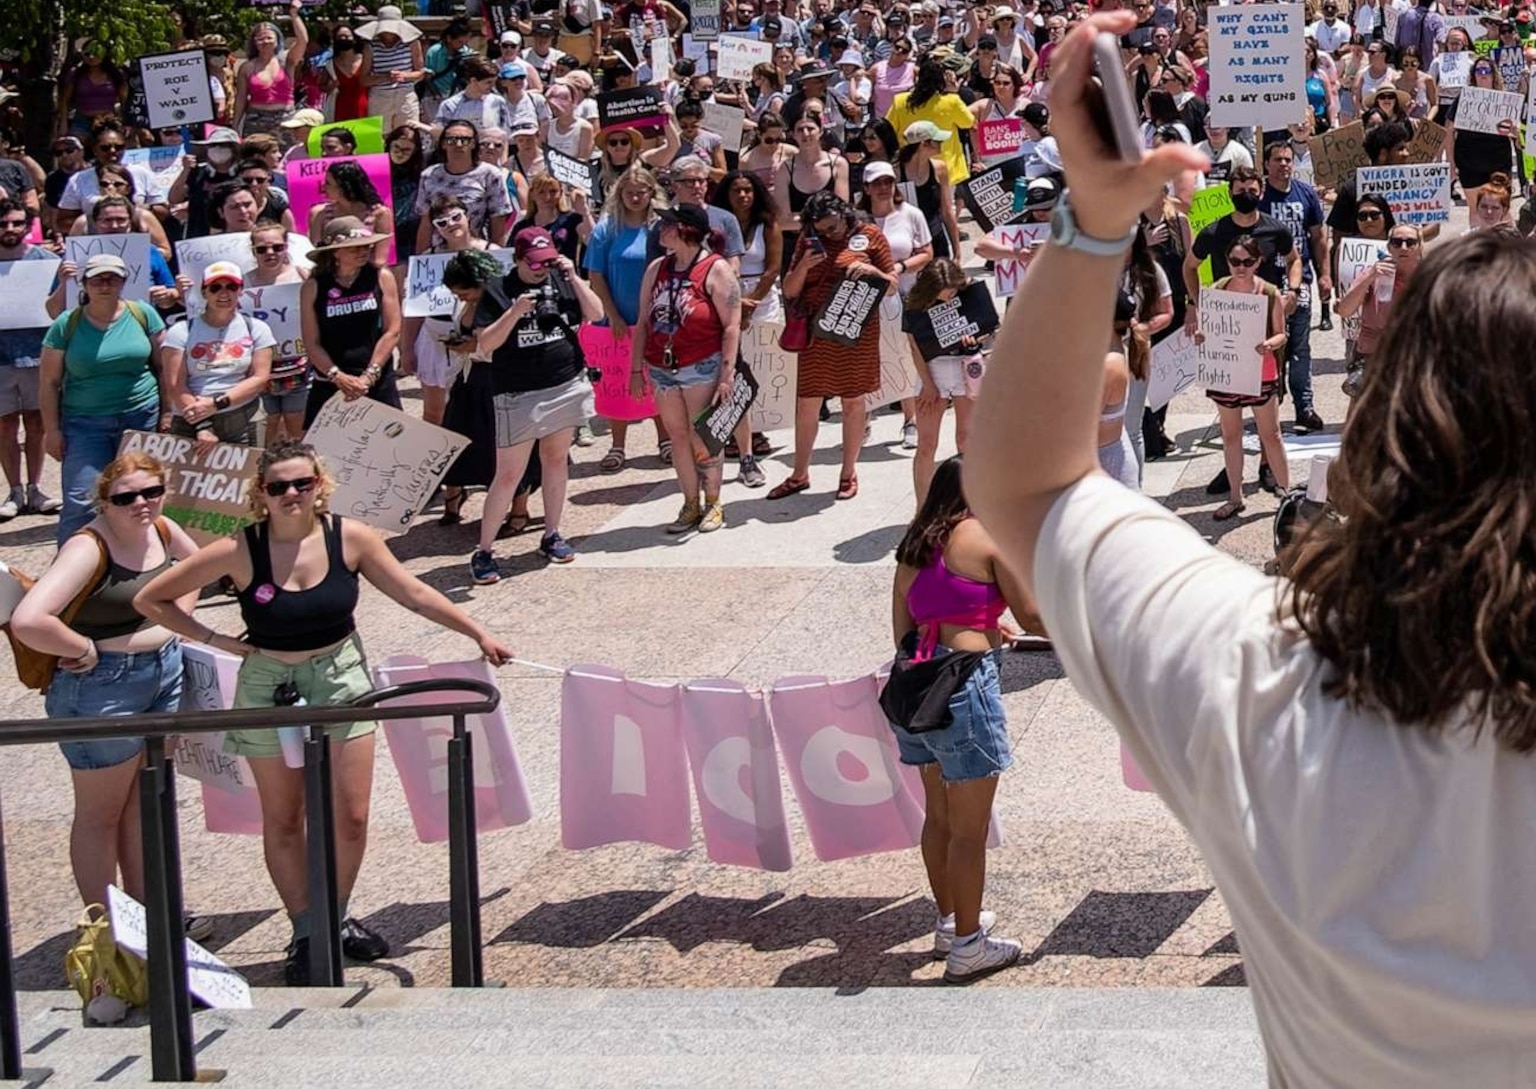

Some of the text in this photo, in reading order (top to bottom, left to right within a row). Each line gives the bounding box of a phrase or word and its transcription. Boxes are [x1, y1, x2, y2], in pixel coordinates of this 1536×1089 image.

[1216, 14, 1242, 23] WHY
[1221, 24, 1289, 34] MY GIRLS
[1233, 41, 1269, 49] HAVE
[144, 57, 202, 71] PROTECT
[1228, 55, 1290, 66] AS MANY
[163, 75, 190, 86] ROE
[1234, 74, 1285, 84] RIGHTS
[171, 87, 180, 95] V
[1218, 92, 1296, 104] AS MY GUNS
[158, 96, 198, 109] WADE
[606, 96, 654, 110] Abortion is
[607, 107, 636, 118] Health
[983, 124, 1010, 136] BANS
[984, 131, 1003, 142] OFF
[1417, 122, 1442, 149] Ruth
[985, 138, 1024, 151] BODIES
[1322, 134, 1356, 156] Pro
[970, 170, 1001, 193] STAND
[1361, 166, 1450, 182] VIAGRA IS GOVT
[1361, 177, 1447, 193] FUNDED IF
[976, 185, 1001, 204] WITH
[1385, 188, 1438, 202] GNANCY
[984, 193, 1014, 215] BLACK
[1270, 202, 1304, 221] HER
[1389, 200, 1443, 214] OD'S WILL
[1400, 211, 1449, 224] LIMP DICK
[1001, 228, 1038, 247] MY
[70, 238, 128, 262] MY
[1342, 244, 1373, 262] NOT
[416, 257, 436, 281] My
[826, 279, 856, 321] BODIES
[928, 296, 960, 316] STAND
[1201, 290, 1261, 314] Reproductive
[932, 311, 959, 327] WITH
[935, 317, 968, 337] BLACK
[1200, 313, 1242, 336] Rights
[940, 324, 979, 347] WOMEN
[1199, 346, 1239, 362] Human
[1199, 362, 1232, 386] Rights
